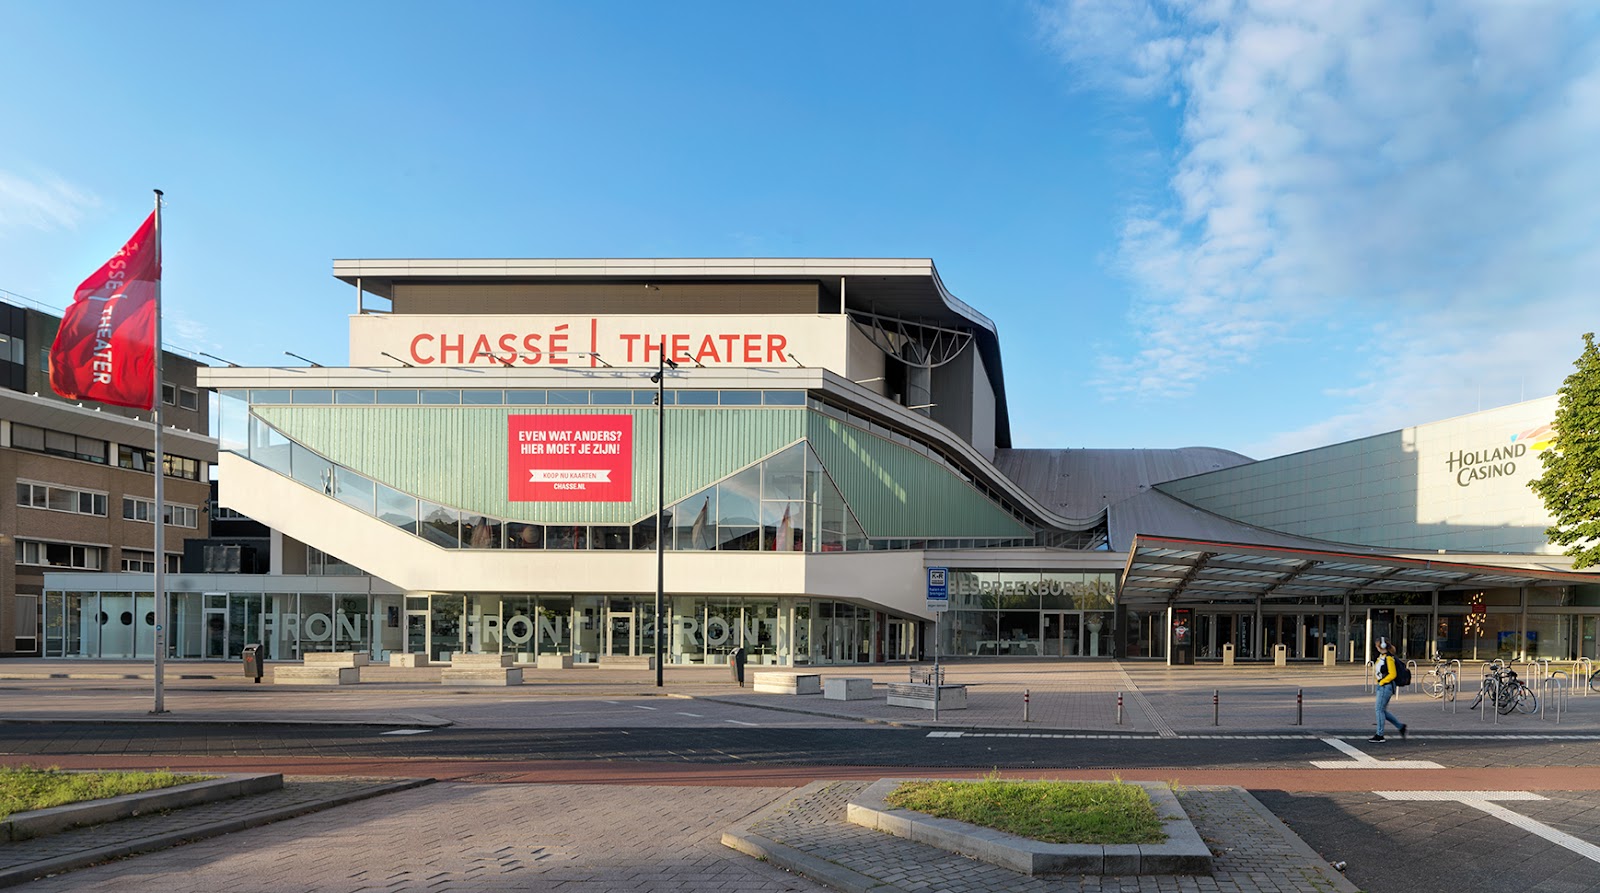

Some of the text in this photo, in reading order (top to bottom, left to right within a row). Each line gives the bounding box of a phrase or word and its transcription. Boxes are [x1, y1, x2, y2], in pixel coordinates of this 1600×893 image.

[93, 305, 113, 385] THEATER
[410, 323, 788, 365] CHASSÉ THEATER
[518, 430, 623, 442] EVEN WAT ANDERS?
[520, 443, 620, 455] HIER MOET JE ZIJN!
[1445, 443, 1527, 473] HOLLAND
[1456, 461, 1517, 487] CASINO
[947, 580, 1111, 597] BESPREEKBUREAU
[258, 612, 387, 642] FRONT
[458, 614, 590, 644] FRONT
